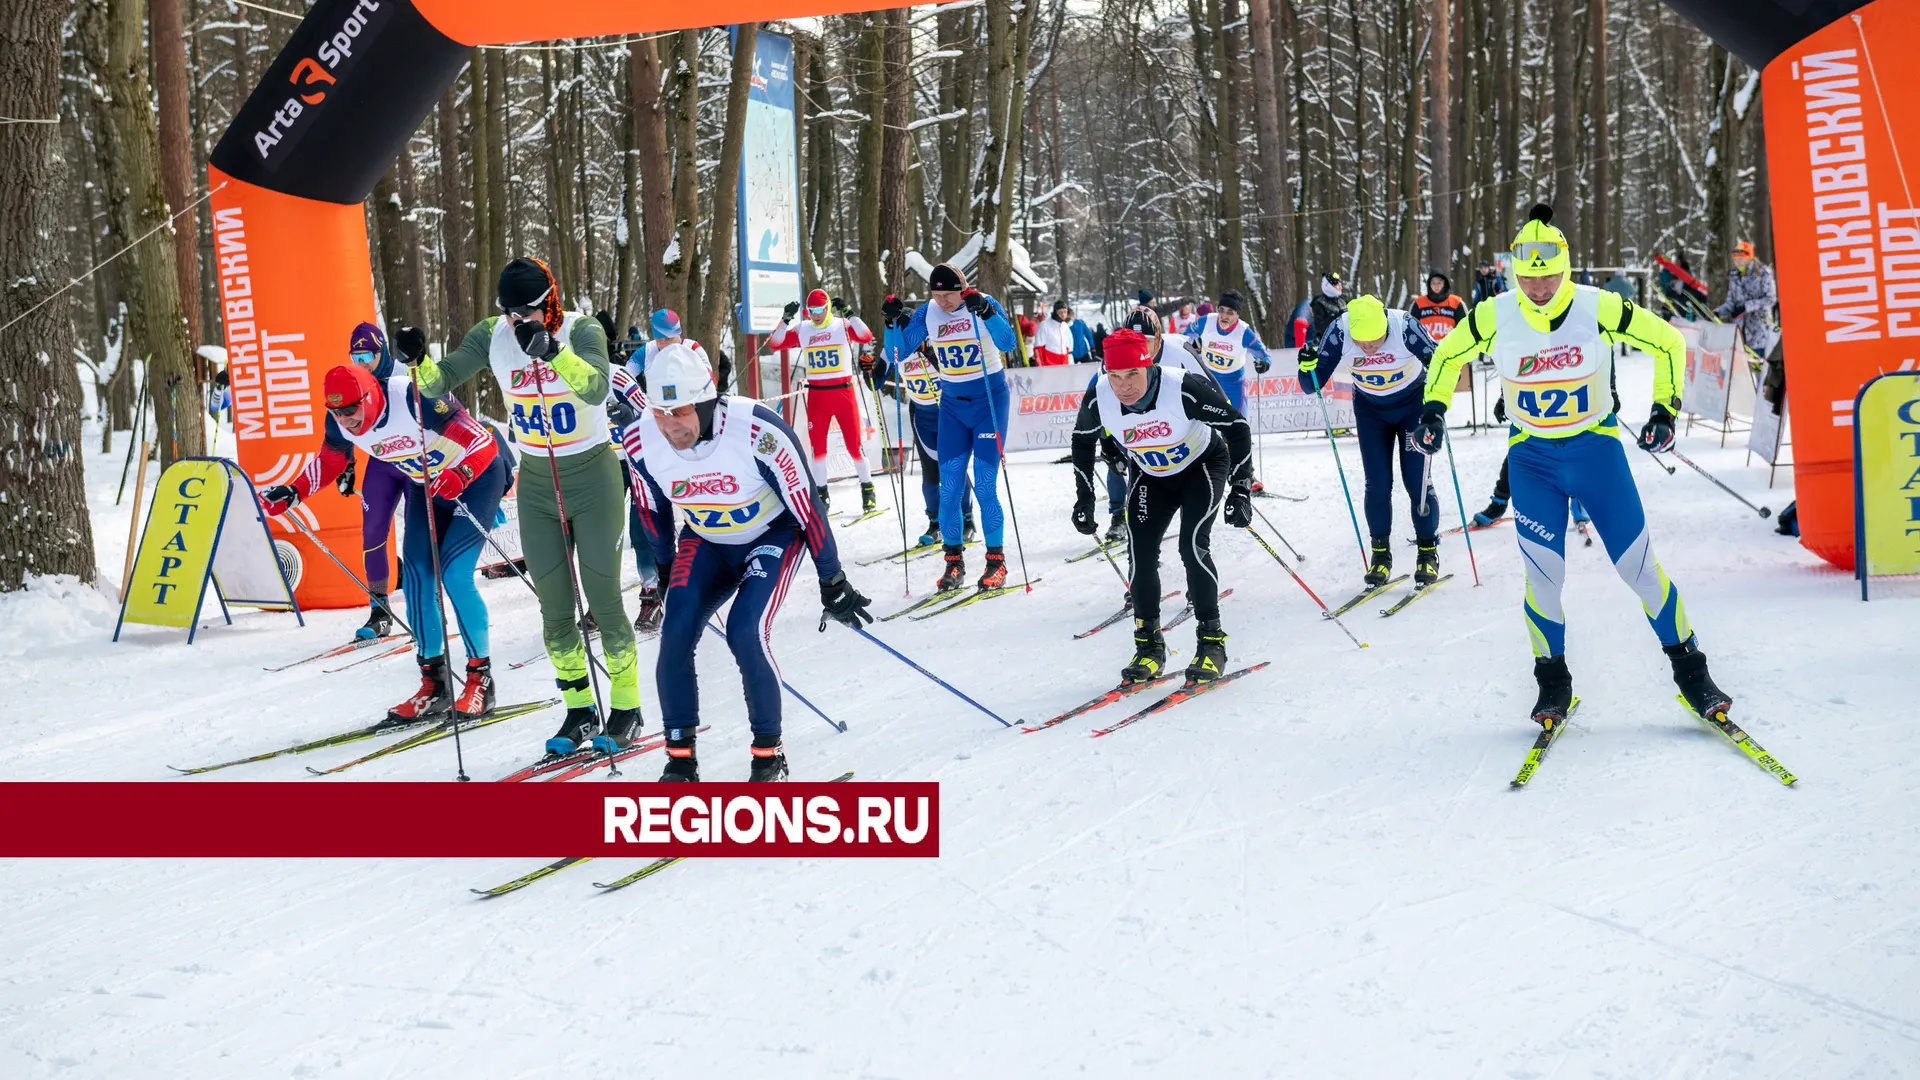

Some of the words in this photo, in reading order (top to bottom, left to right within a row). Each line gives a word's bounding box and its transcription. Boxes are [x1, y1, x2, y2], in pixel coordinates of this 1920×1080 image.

[254, 98, 304, 159] Arta
[318, 0, 380, 69] Sport
[1791, 48, 1881, 343] МОСКОВСКИЙ
[213, 207, 266, 441] МОСКОВСКИЙ
[808, 349, 840, 369] 435
[937, 344, 982, 369] 432
[1206, 352, 1234, 367] 437
[261, 329, 314, 438] СПОРТ
[1019, 391, 1087, 414] ВОЛК
[1202, 404, 1223, 415] CRAFT
[1517, 384, 1589, 418] 421
[513, 402, 577, 436] 440
[1025, 429, 1070, 445] VOLK
[775, 447, 801, 491] LUKOIL
[1138, 485, 1148, 515] CRAFT
[152, 477, 206, 605] СТАРТ
[1513, 506, 1555, 542] portful
[375, 721, 430, 737] FISCHER
